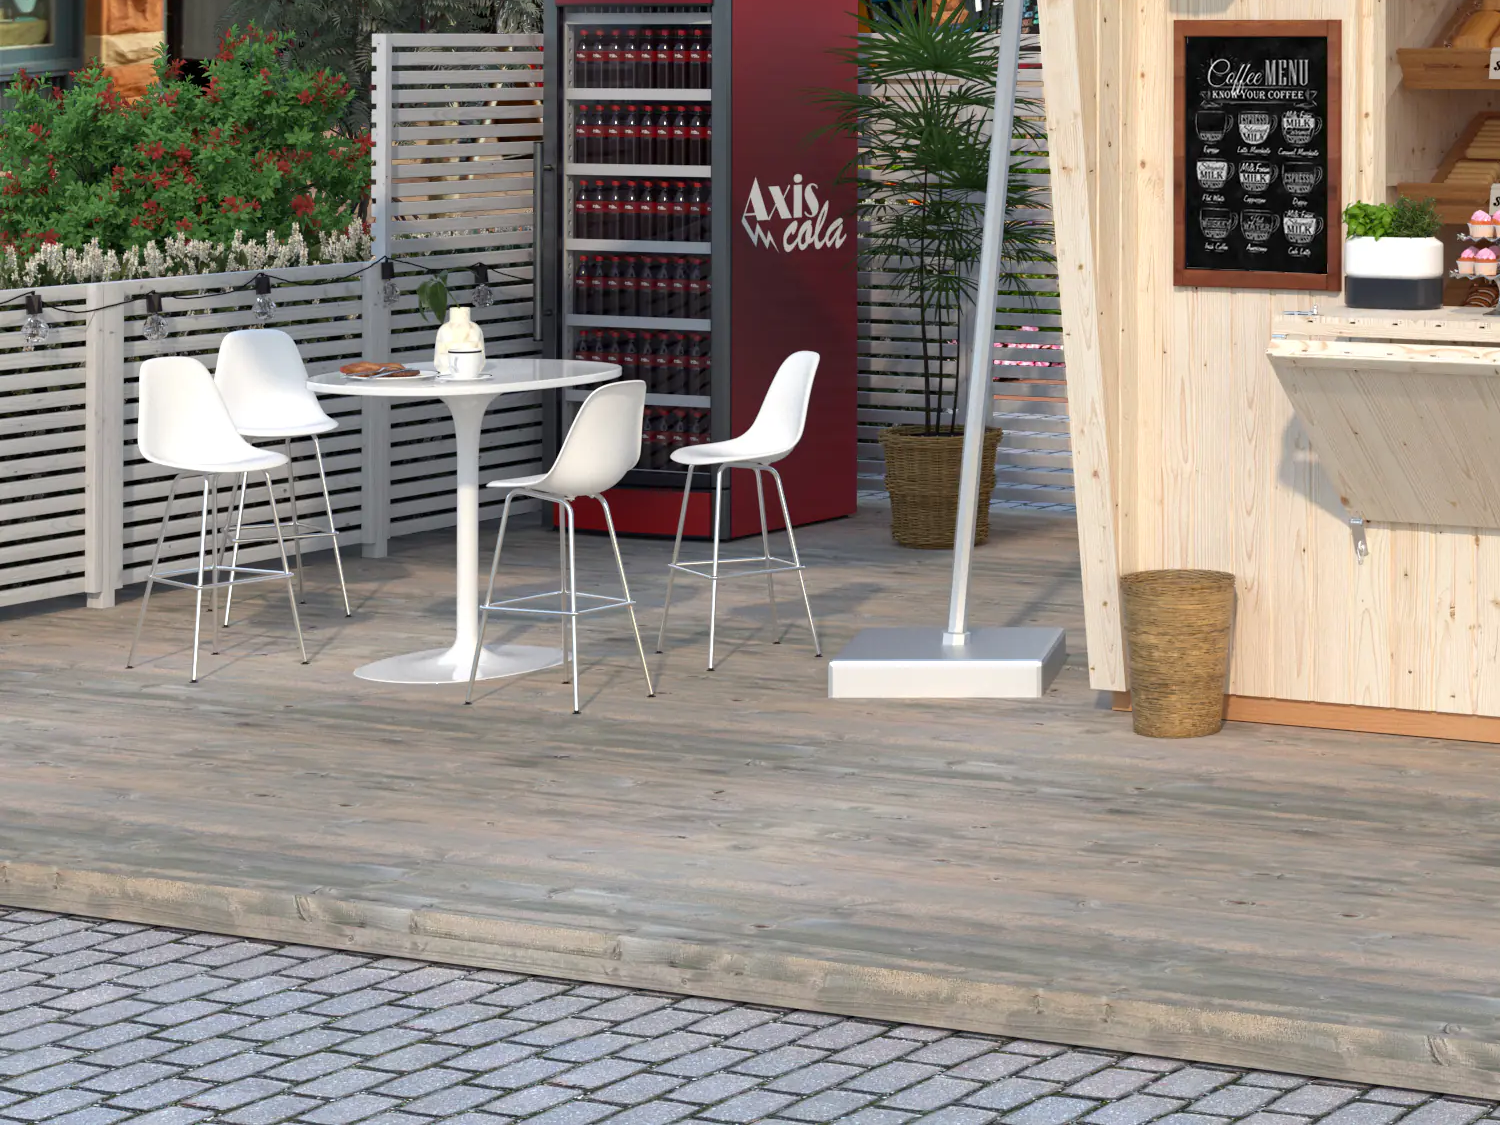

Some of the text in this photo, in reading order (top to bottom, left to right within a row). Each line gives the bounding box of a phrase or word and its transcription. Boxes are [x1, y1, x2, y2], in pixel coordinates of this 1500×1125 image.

[1207, 58, 1309, 95] Coffee MENU
[1241, 90, 1266, 100] YOUR
[1267, 90, 1304, 100] COFFEE
[1286, 118, 1311, 127] MILK
[1201, 171, 1224, 181] MILK
[1242, 174, 1267, 184] MILK
[742, 173, 820, 222] Axis
[783, 200, 847, 253] cola
[1286, 224, 1312, 235] MILK
